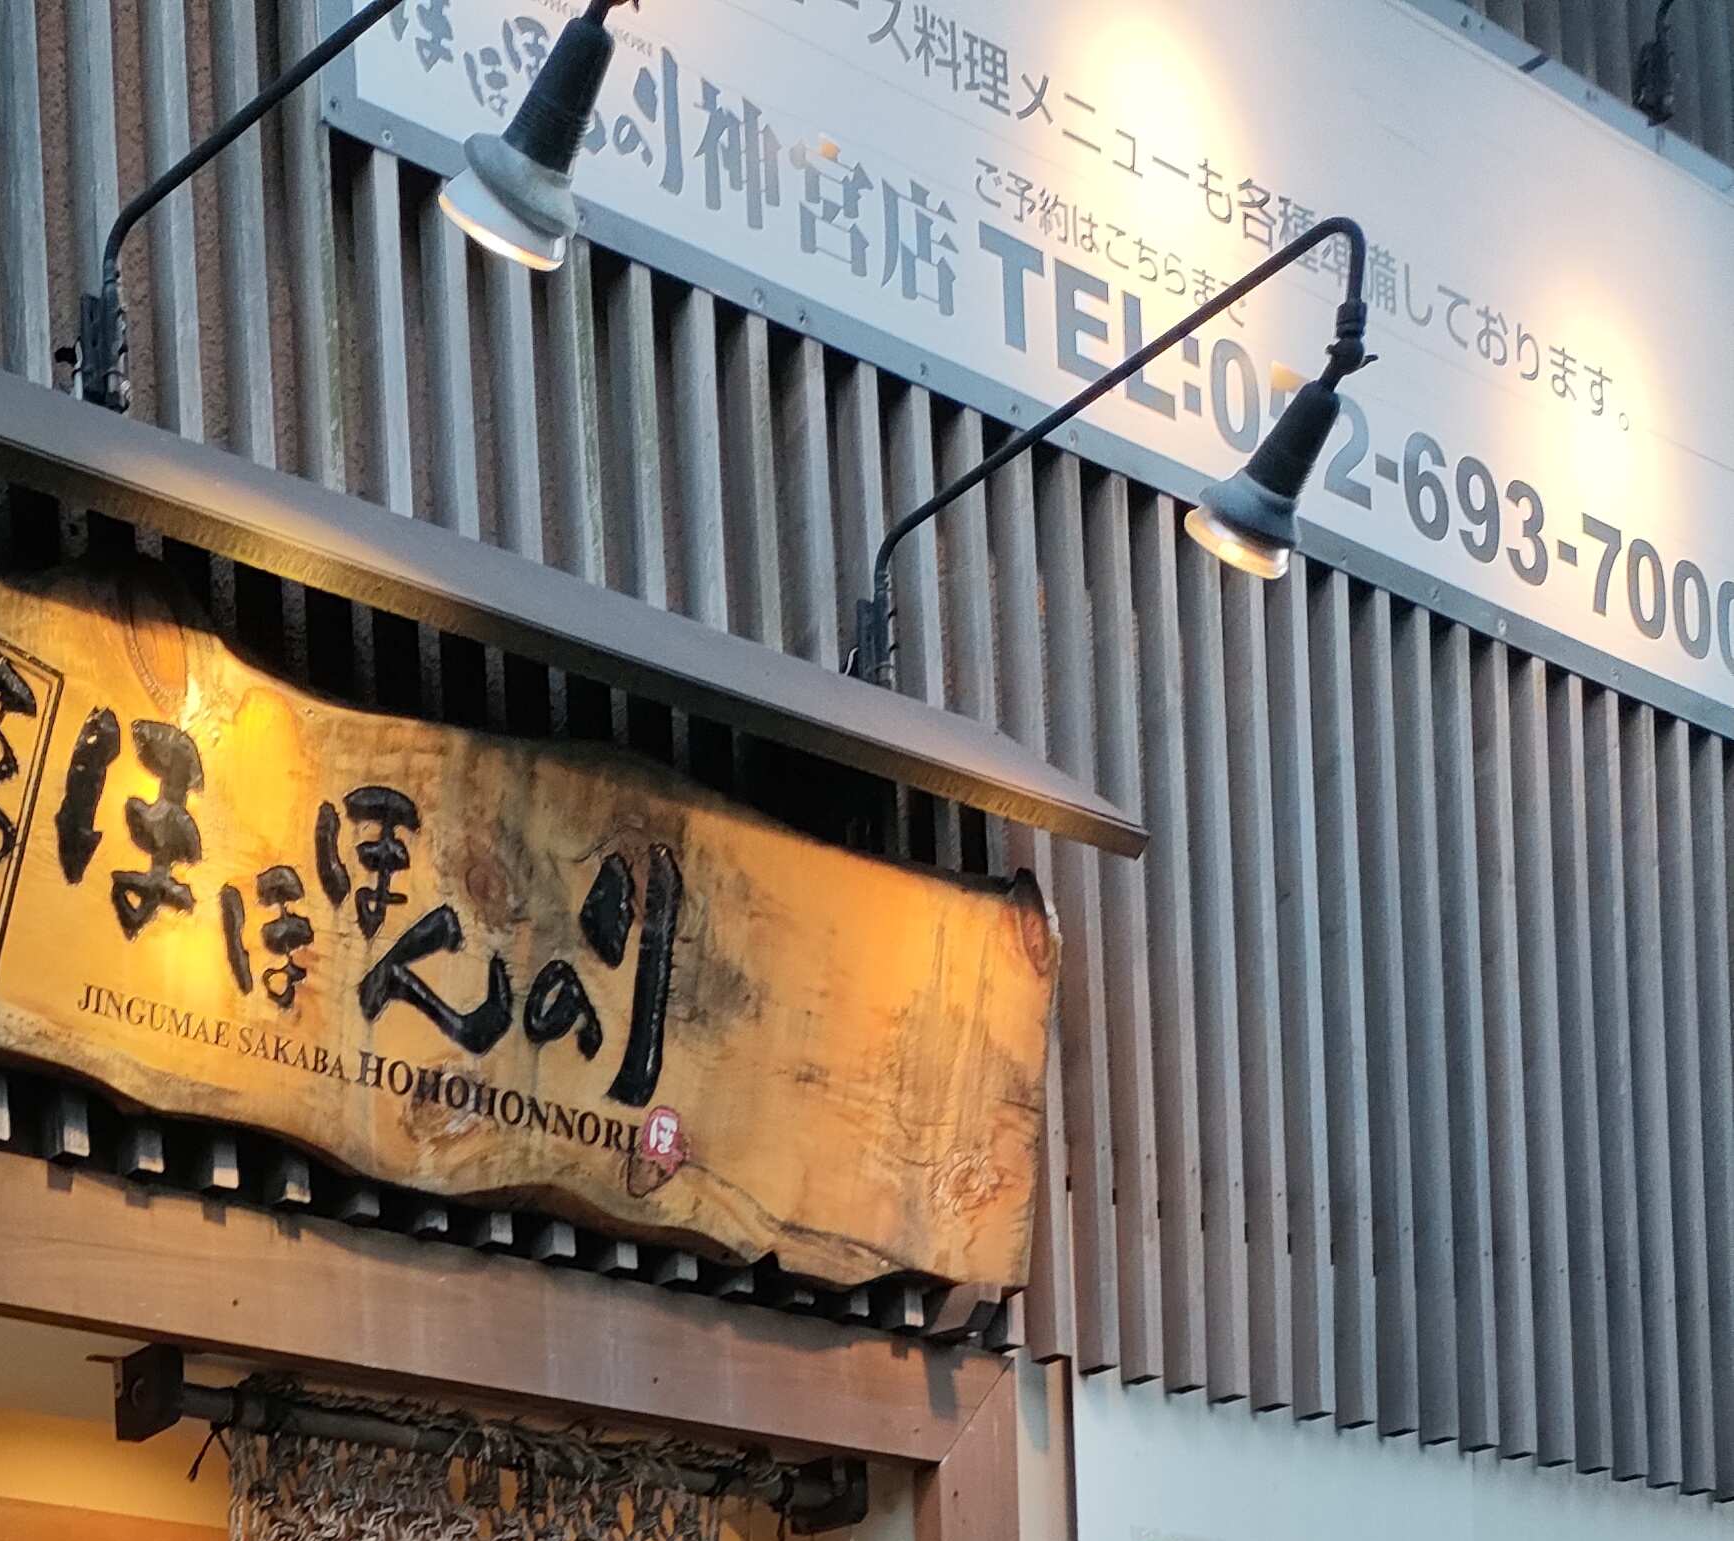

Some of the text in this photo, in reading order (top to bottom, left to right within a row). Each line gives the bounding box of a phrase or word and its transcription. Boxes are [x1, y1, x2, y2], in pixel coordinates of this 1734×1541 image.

[695, 77, 960, 317] 神宮店
[975, 157, 1245, 328] ご予約はこちらまで
[56, 706, 683, 1107] ほほほんのり
[76, 983, 643, 1153] JINGUMAE SAKABA HOHOHONNORI
